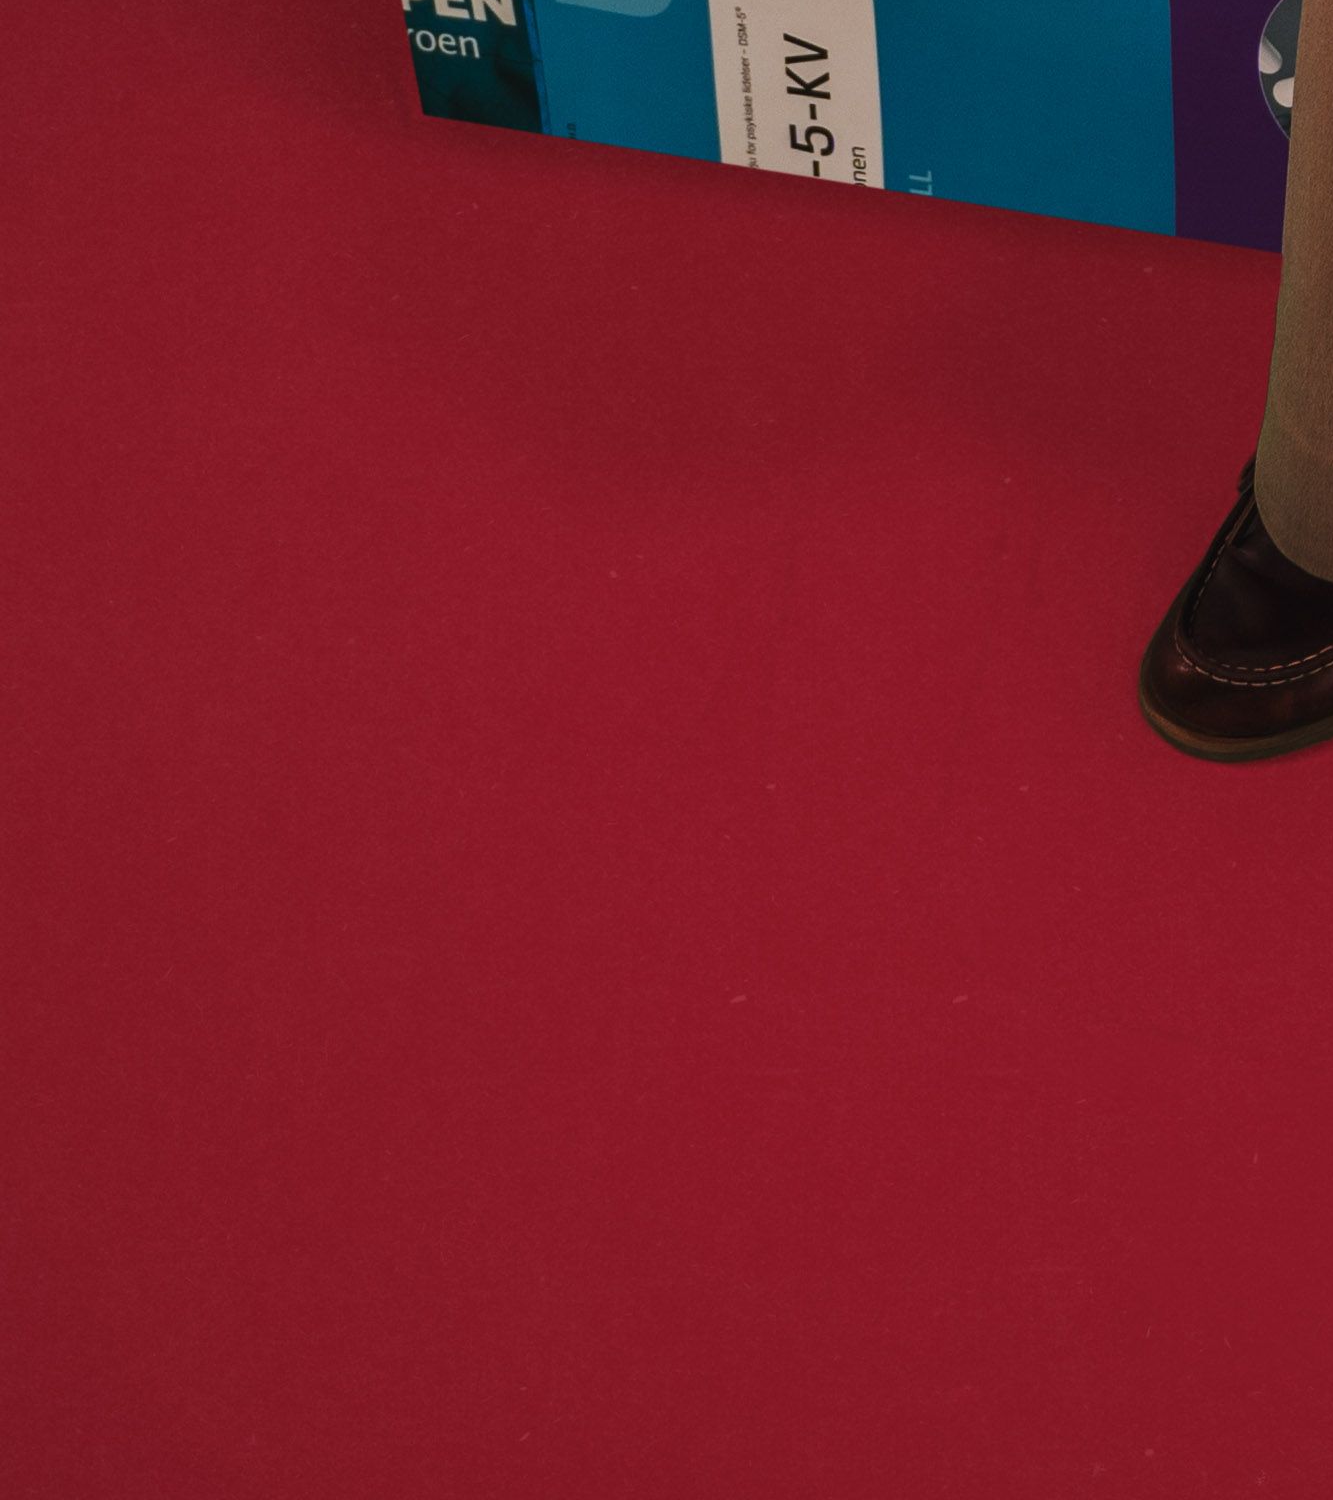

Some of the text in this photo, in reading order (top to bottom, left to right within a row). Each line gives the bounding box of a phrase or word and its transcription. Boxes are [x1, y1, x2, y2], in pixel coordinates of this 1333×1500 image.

[739, 56, 754, 99] lidelser
[743, 98, 758, 141] psykiske
[782, 32, 835, 178] -5-KV
